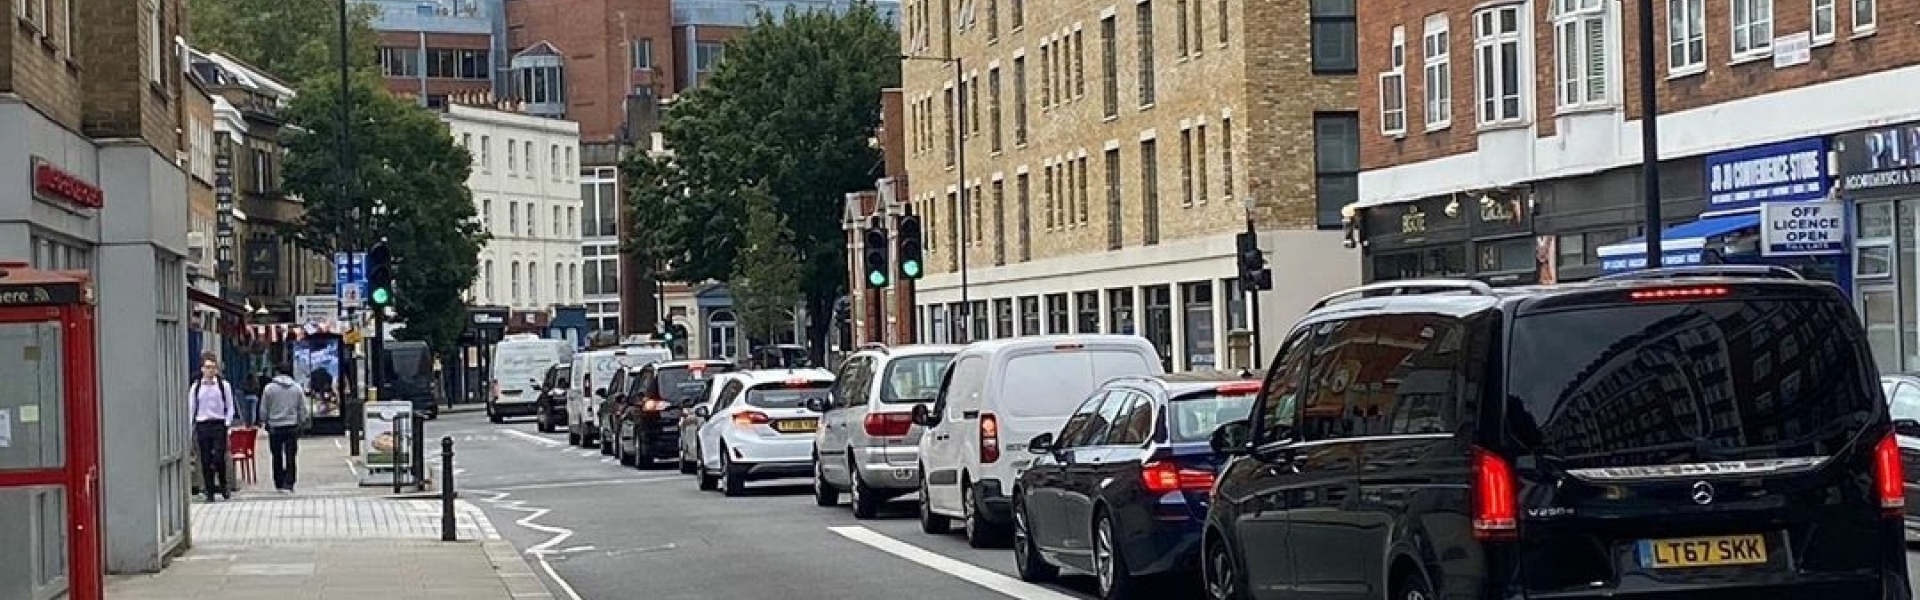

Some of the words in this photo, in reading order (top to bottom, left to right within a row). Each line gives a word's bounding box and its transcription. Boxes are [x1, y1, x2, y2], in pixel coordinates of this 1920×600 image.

[1791, 206, 1821, 218] OFF
[1773, 217, 1839, 231] LICENCE
[1786, 230, 1829, 242] OPEN
[1653, 541, 1710, 564] LT67
[1720, 538, 1762, 560] SKK
